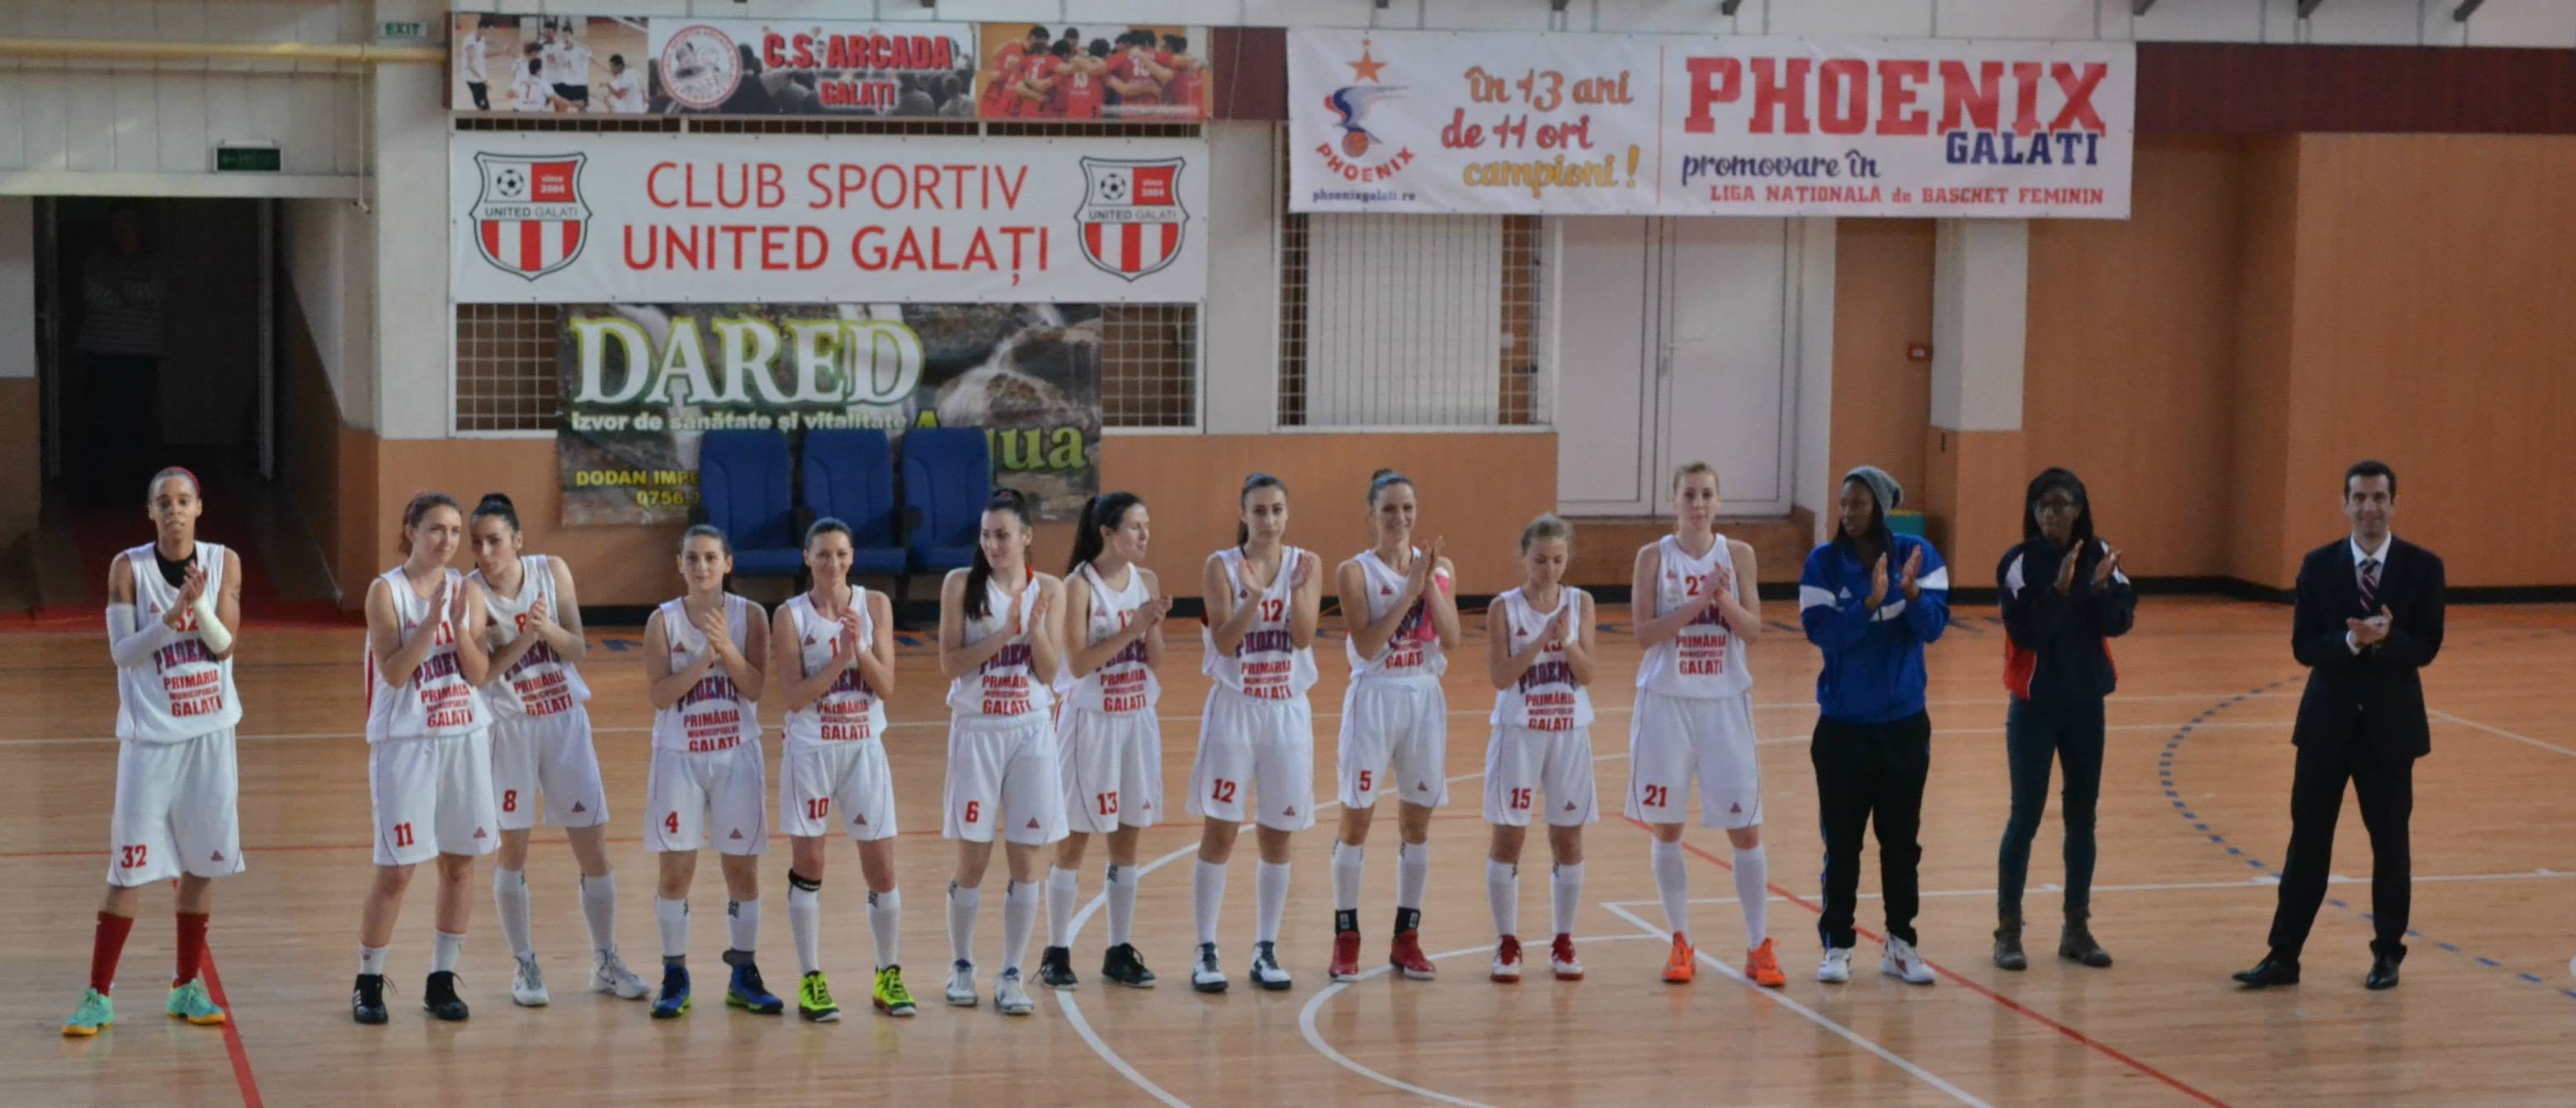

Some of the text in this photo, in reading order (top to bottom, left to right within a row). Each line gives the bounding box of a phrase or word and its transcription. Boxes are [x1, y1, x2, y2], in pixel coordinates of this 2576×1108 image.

[385, 22, 420, 35] EXIT
[762, 33, 821, 68] C.S.
[828, 35, 953, 69] ARCADA
[1464, 65, 1511, 103] în
[1573, 70, 1635, 104] ani
[1684, 55, 2108, 138] PHOENIX
[1441, 107, 1486, 149] de
[1536, 115, 1594, 149] ori
[1946, 132, 2098, 165] GALATI
[1315, 143, 1415, 182] PHOENIX
[1682, 149, 1880, 186] promovare în
[647, 162, 1028, 210] CLUB SPORTIV
[1464, 153, 1620, 199] campioni
[1710, 186, 1755, 202] LIGA
[1892, 187, 1912, 204] de
[1922, 187, 2009, 204] BASCHET
[2018, 188, 2104, 205] FEMININ
[485, 207, 531, 218] UNITED
[1088, 210, 1133, 220] UNITED
[624, 224, 829, 271] UNITED
[570, 317, 925, 407] DARED
[634, 412, 663, 431] de
[804, 411, 908, 431] vitalitate
[576, 469, 647, 486] DODAN
[1262, 599, 1283, 622] 12
[1212, 777, 1236, 804] 12
[1359, 770, 1372, 792] 5
[502, 790, 517, 813] 8
[1097, 791, 1118, 815] 13
[1511, 787, 1531, 810] 15
[1642, 784, 1668, 808] 21
[807, 797, 829, 820] 10
[965, 800, 979, 823] 6
[665, 810, 679, 834] 4
[394, 822, 414, 847] 11
[121, 844, 147, 868] 32
